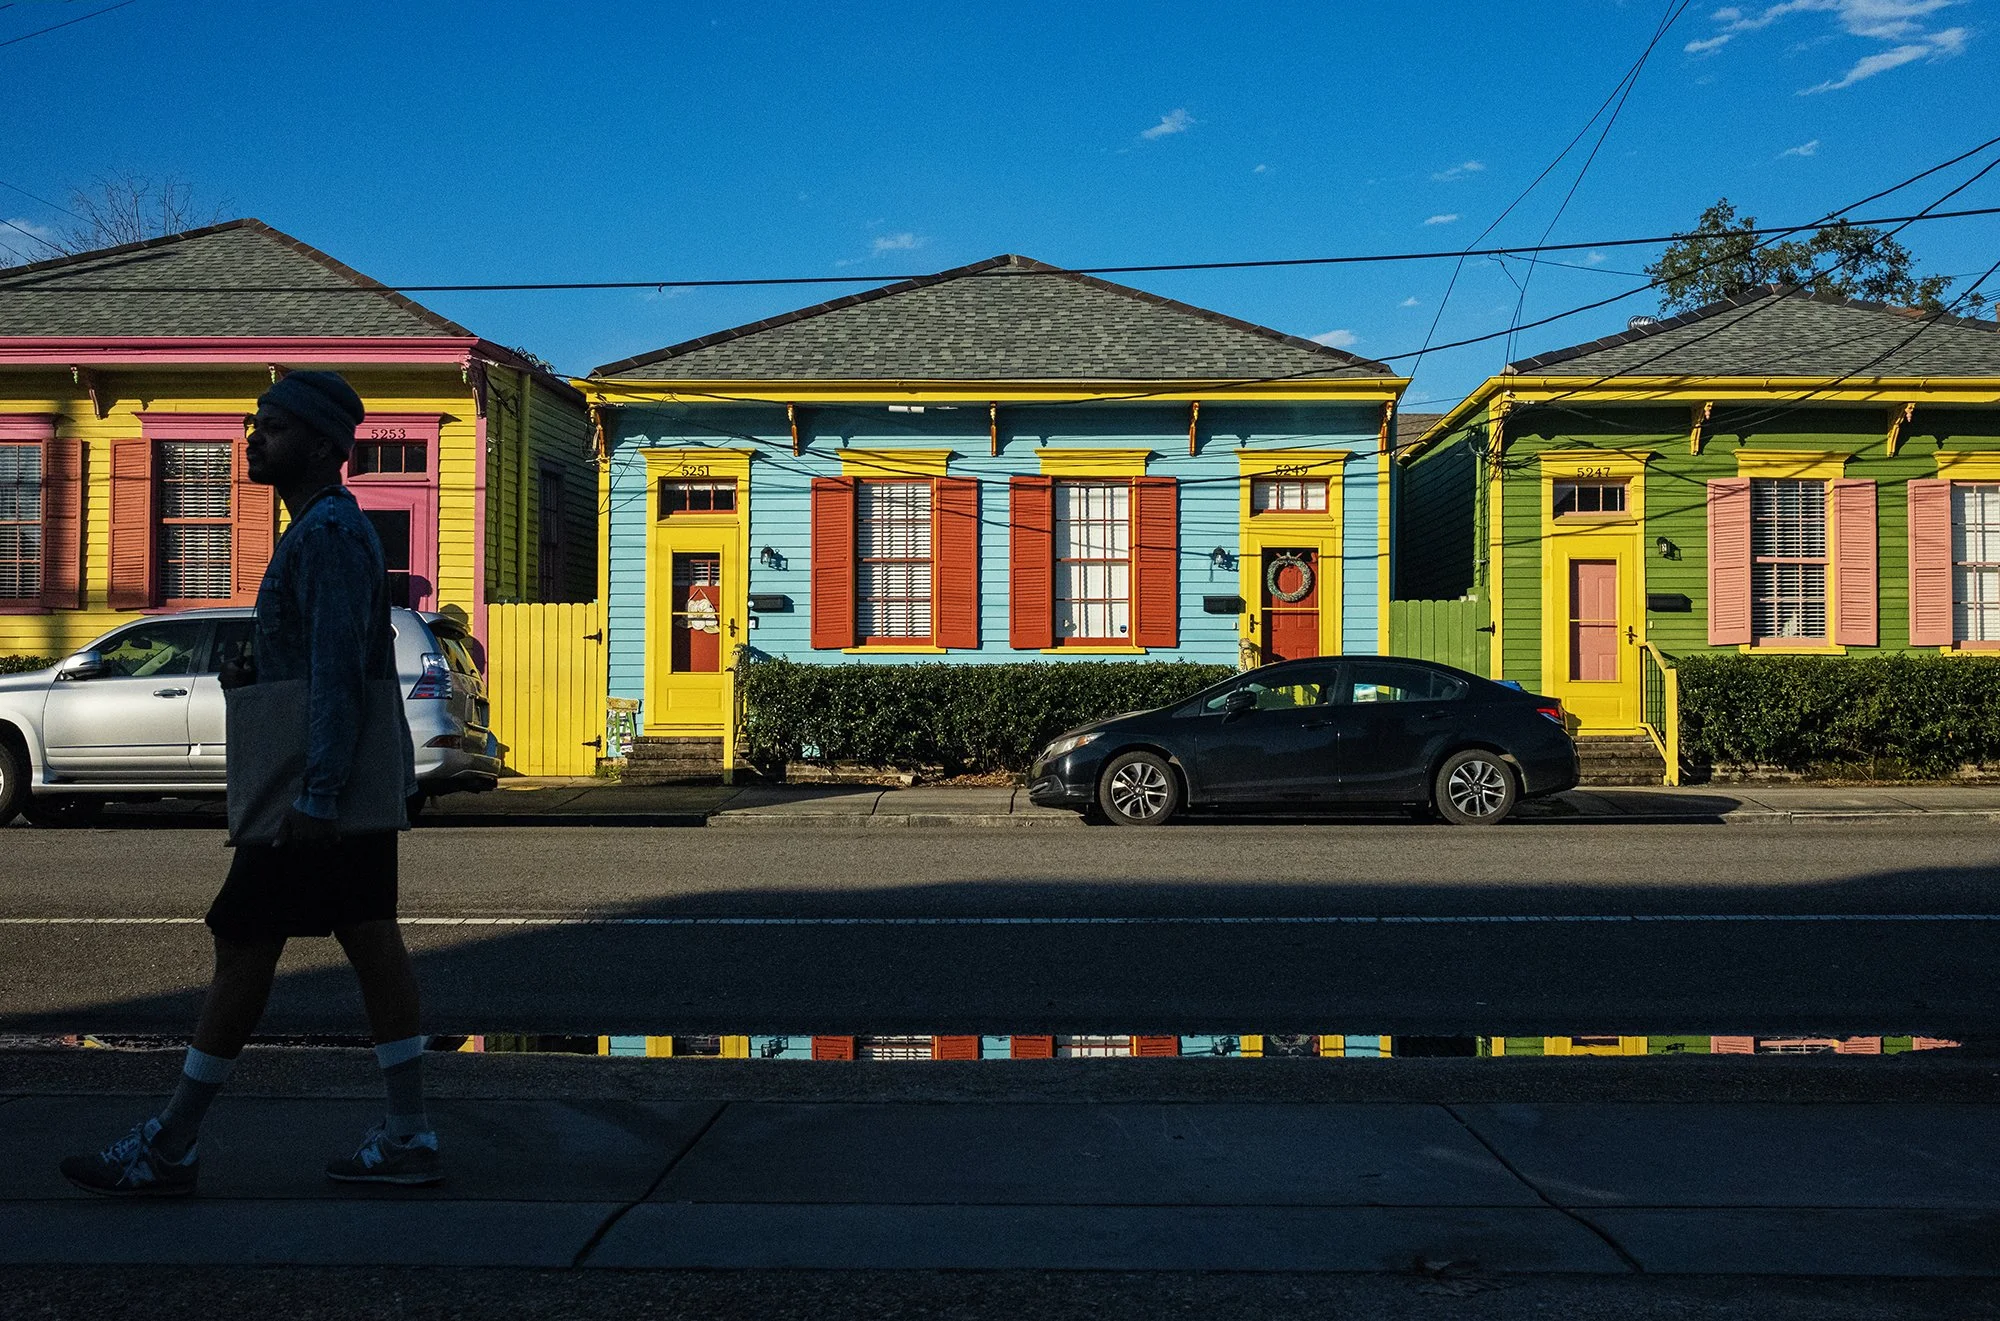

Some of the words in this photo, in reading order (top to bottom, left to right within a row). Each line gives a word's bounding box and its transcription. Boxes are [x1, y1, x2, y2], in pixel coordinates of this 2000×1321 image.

[371, 428, 406, 439] 5253
[682, 465, 710, 477] 5251
[1276, 464, 1308, 477] 5249
[1577, 467, 1610, 478] 5247
